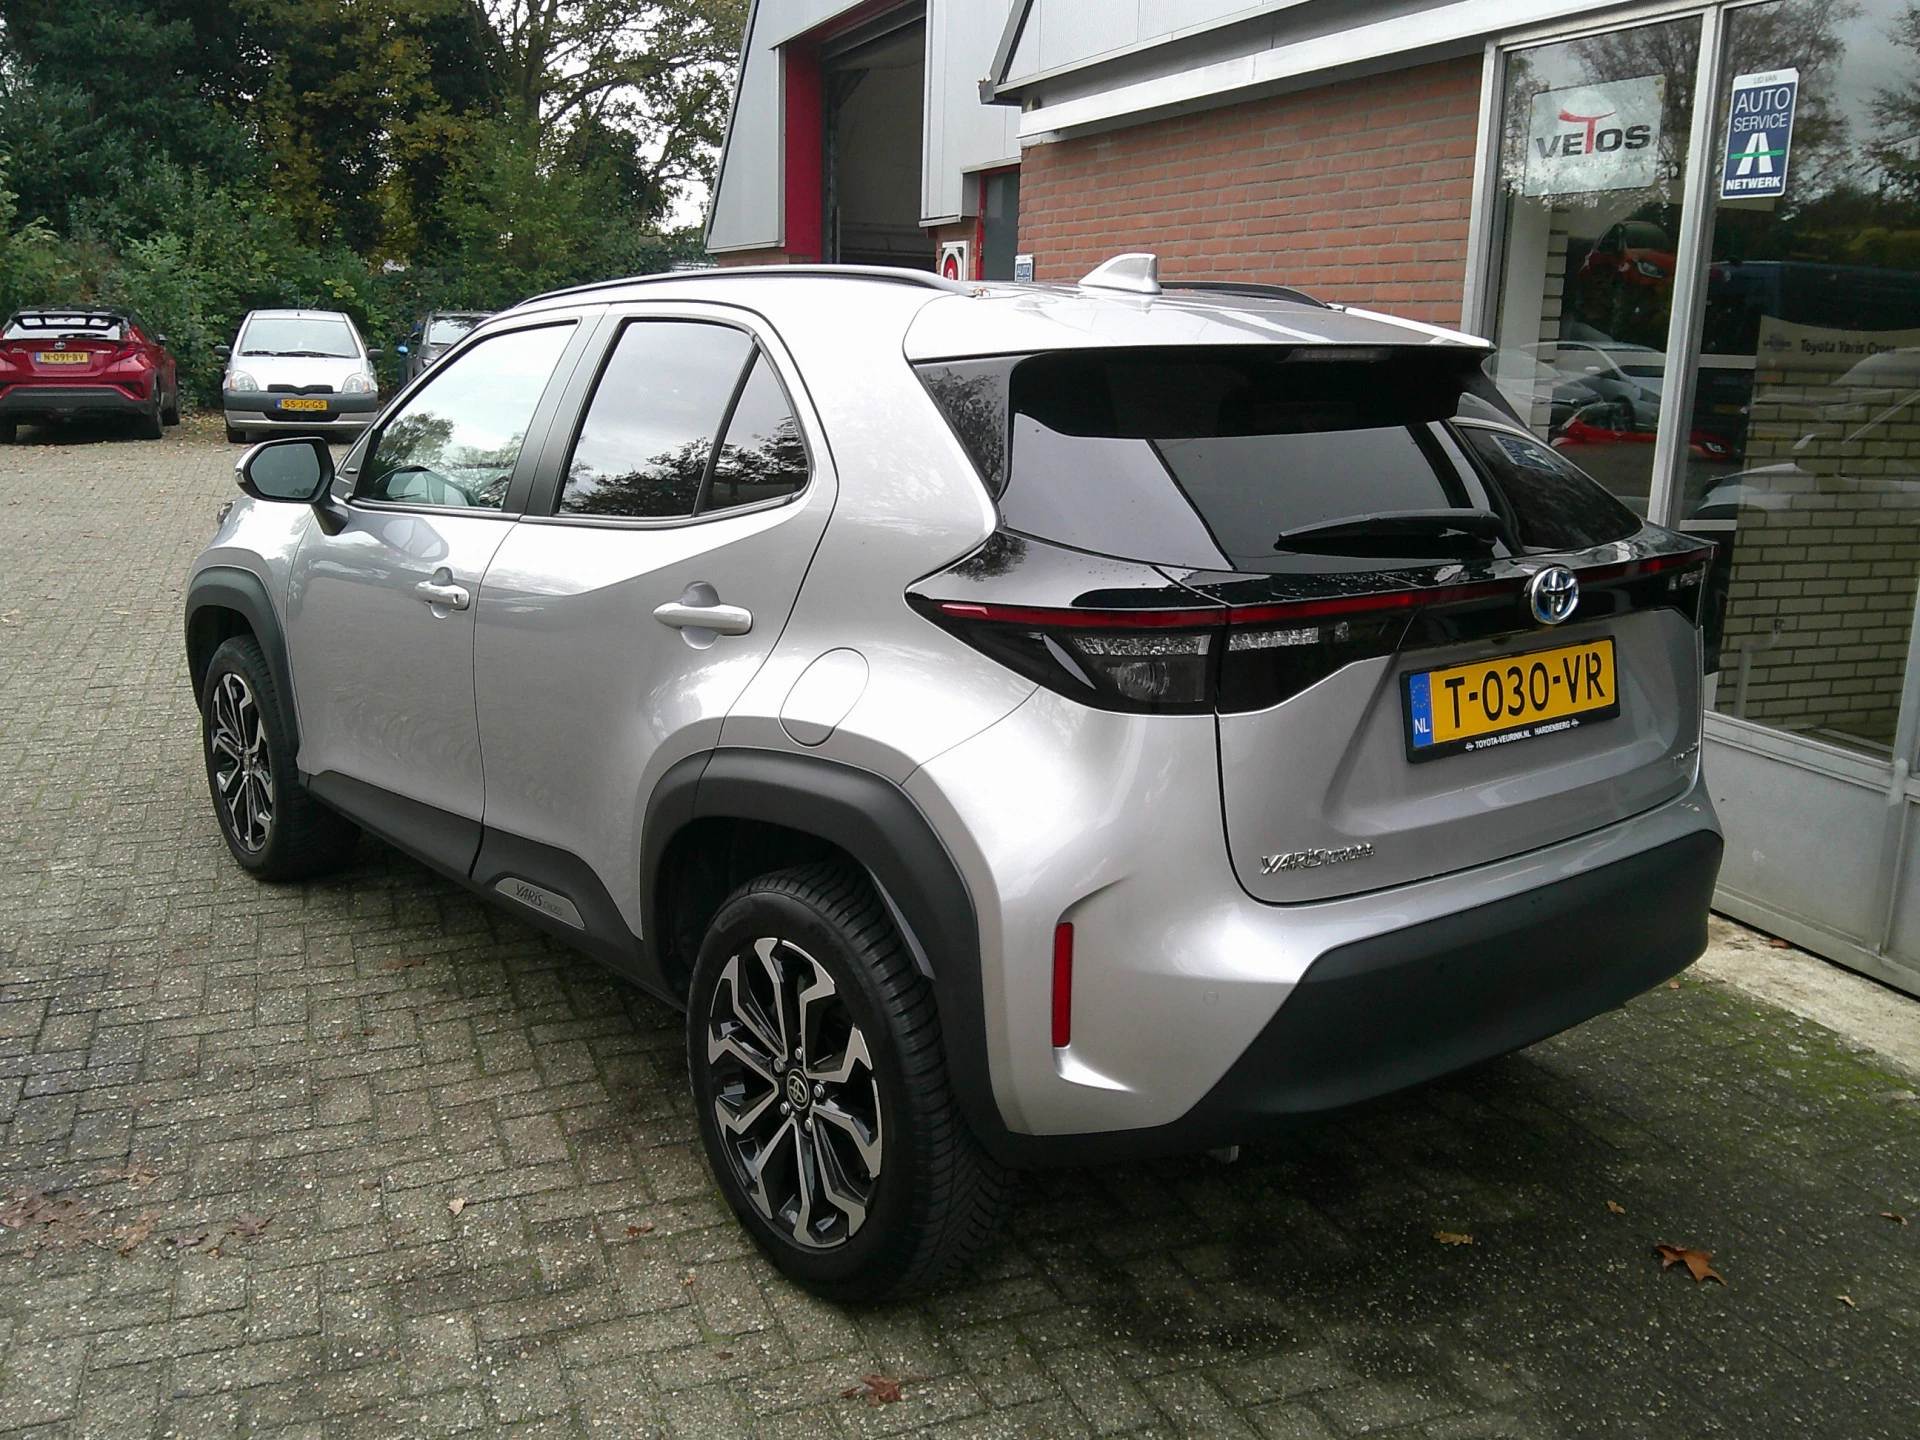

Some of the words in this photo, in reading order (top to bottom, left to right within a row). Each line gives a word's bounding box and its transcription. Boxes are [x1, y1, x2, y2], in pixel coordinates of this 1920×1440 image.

[1735, 86, 1791, 114] AUTO
[1733, 112, 1789, 132] SERVICE
[1536, 109, 1651, 159] VETOS
[1725, 175, 1781, 191] NETWERK
[1801, 338, 1836, 356] Toyota
[1839, 340, 1865, 354] Yaris
[43, 353, 84, 361] N-091-BV
[284, 400, 324, 409] 55-JG-GS
[1444, 651, 1606, 729] T-030-VR
[1414, 717, 1430, 735] NL
[1475, 729, 1532, 749] TOYOTA-VEURINK.NL
[1534, 720, 1571, 736] HARDENBERG
